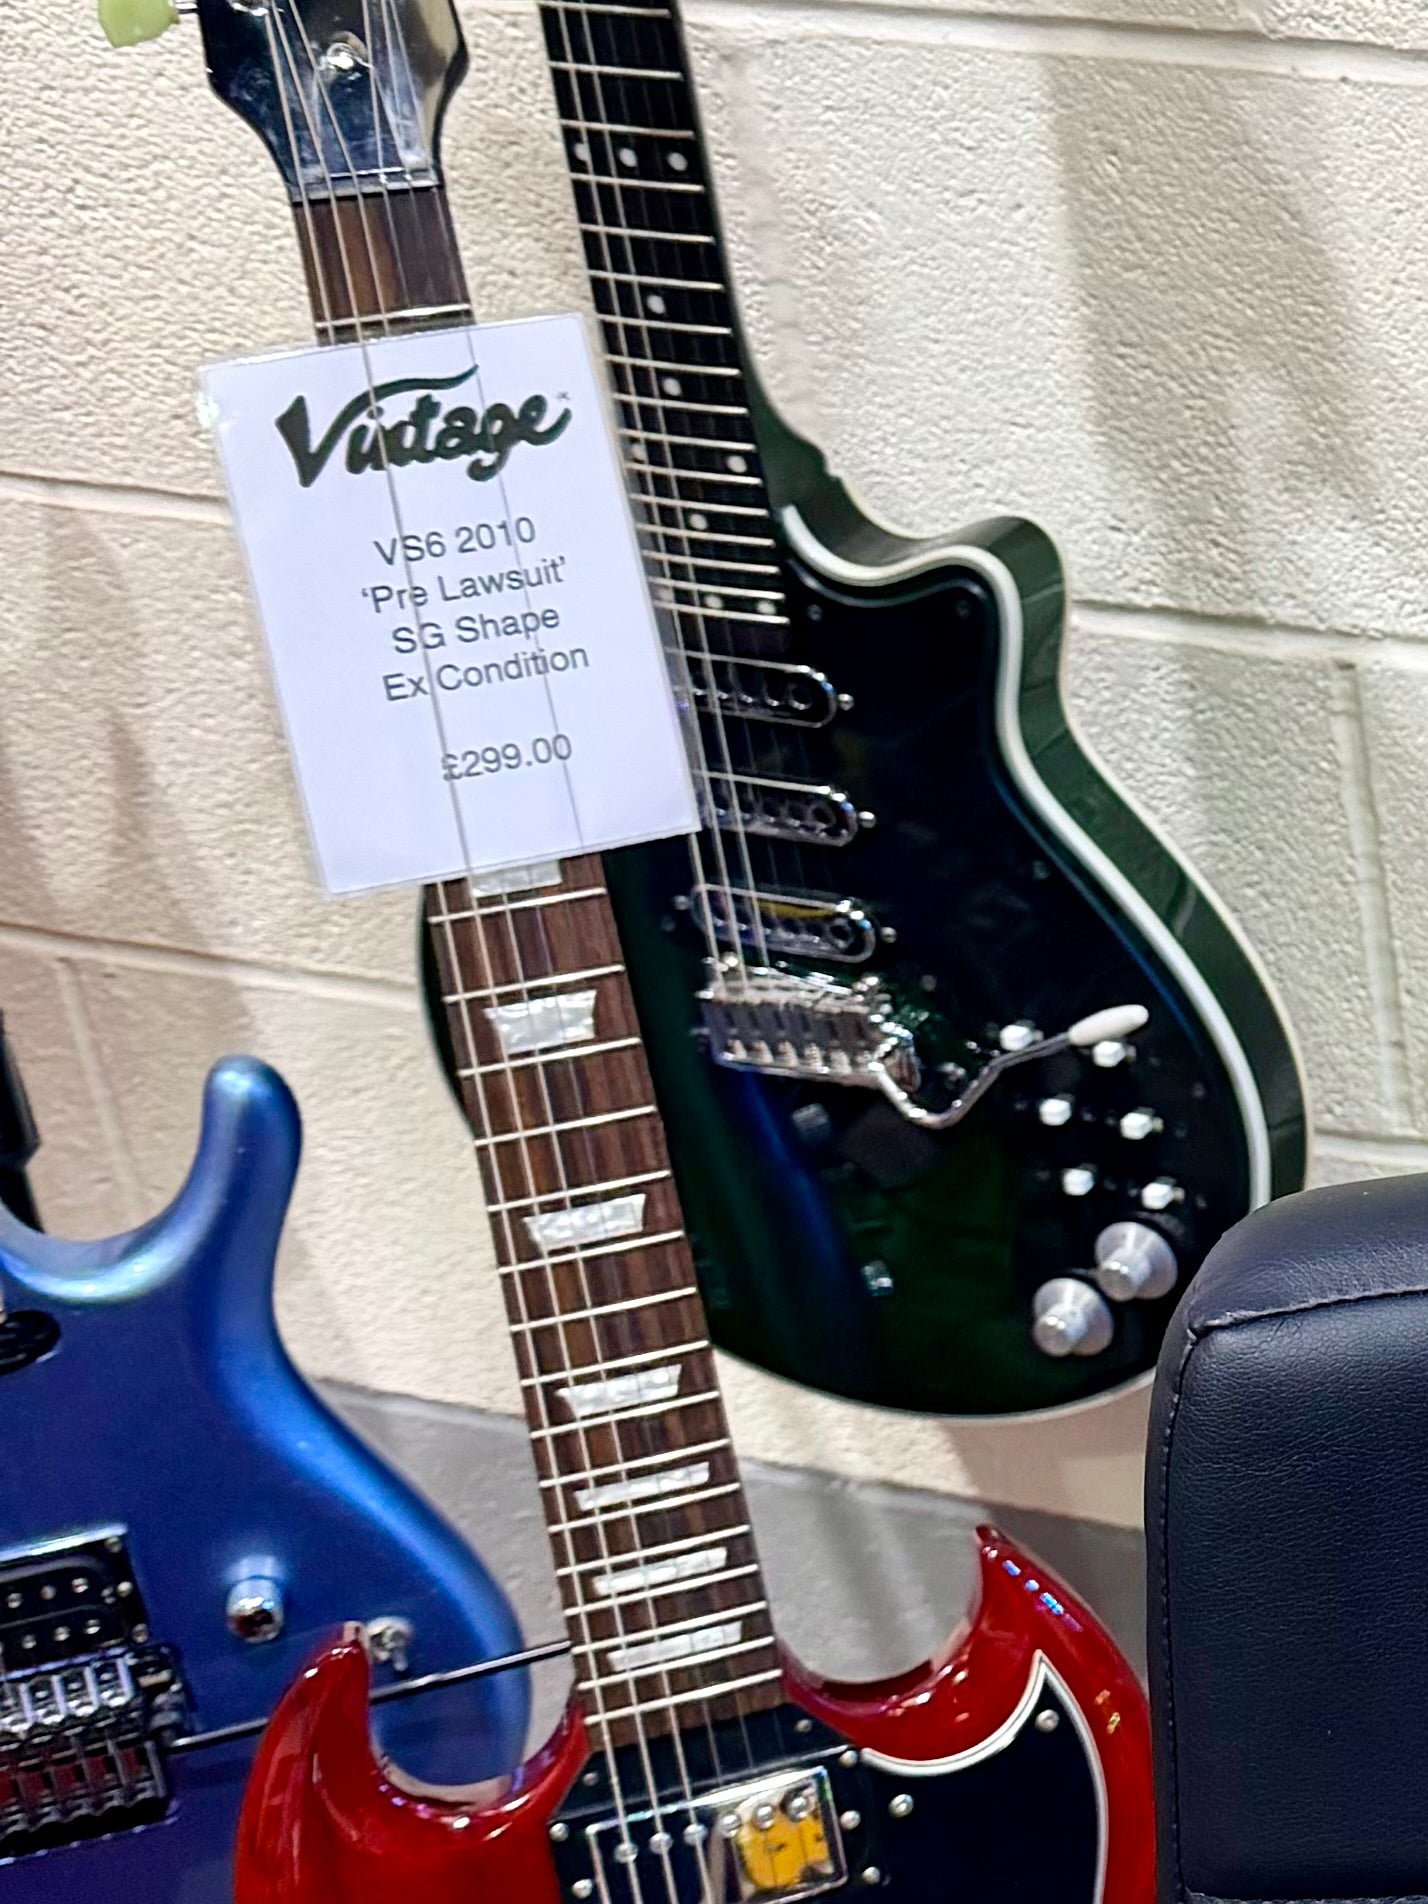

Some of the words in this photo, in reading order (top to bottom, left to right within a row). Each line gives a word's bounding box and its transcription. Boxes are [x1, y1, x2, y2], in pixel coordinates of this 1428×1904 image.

[275, 363, 572, 488] Vintage
[373, 530, 447, 567] VS6
[454, 516, 536, 554] 2010
[391, 621, 447, 654] SG
[454, 607, 560, 644] Shape
[382, 672, 429, 702] Ex
[436, 646, 590, 692] Condition
[440, 733, 572, 782] £299.00
